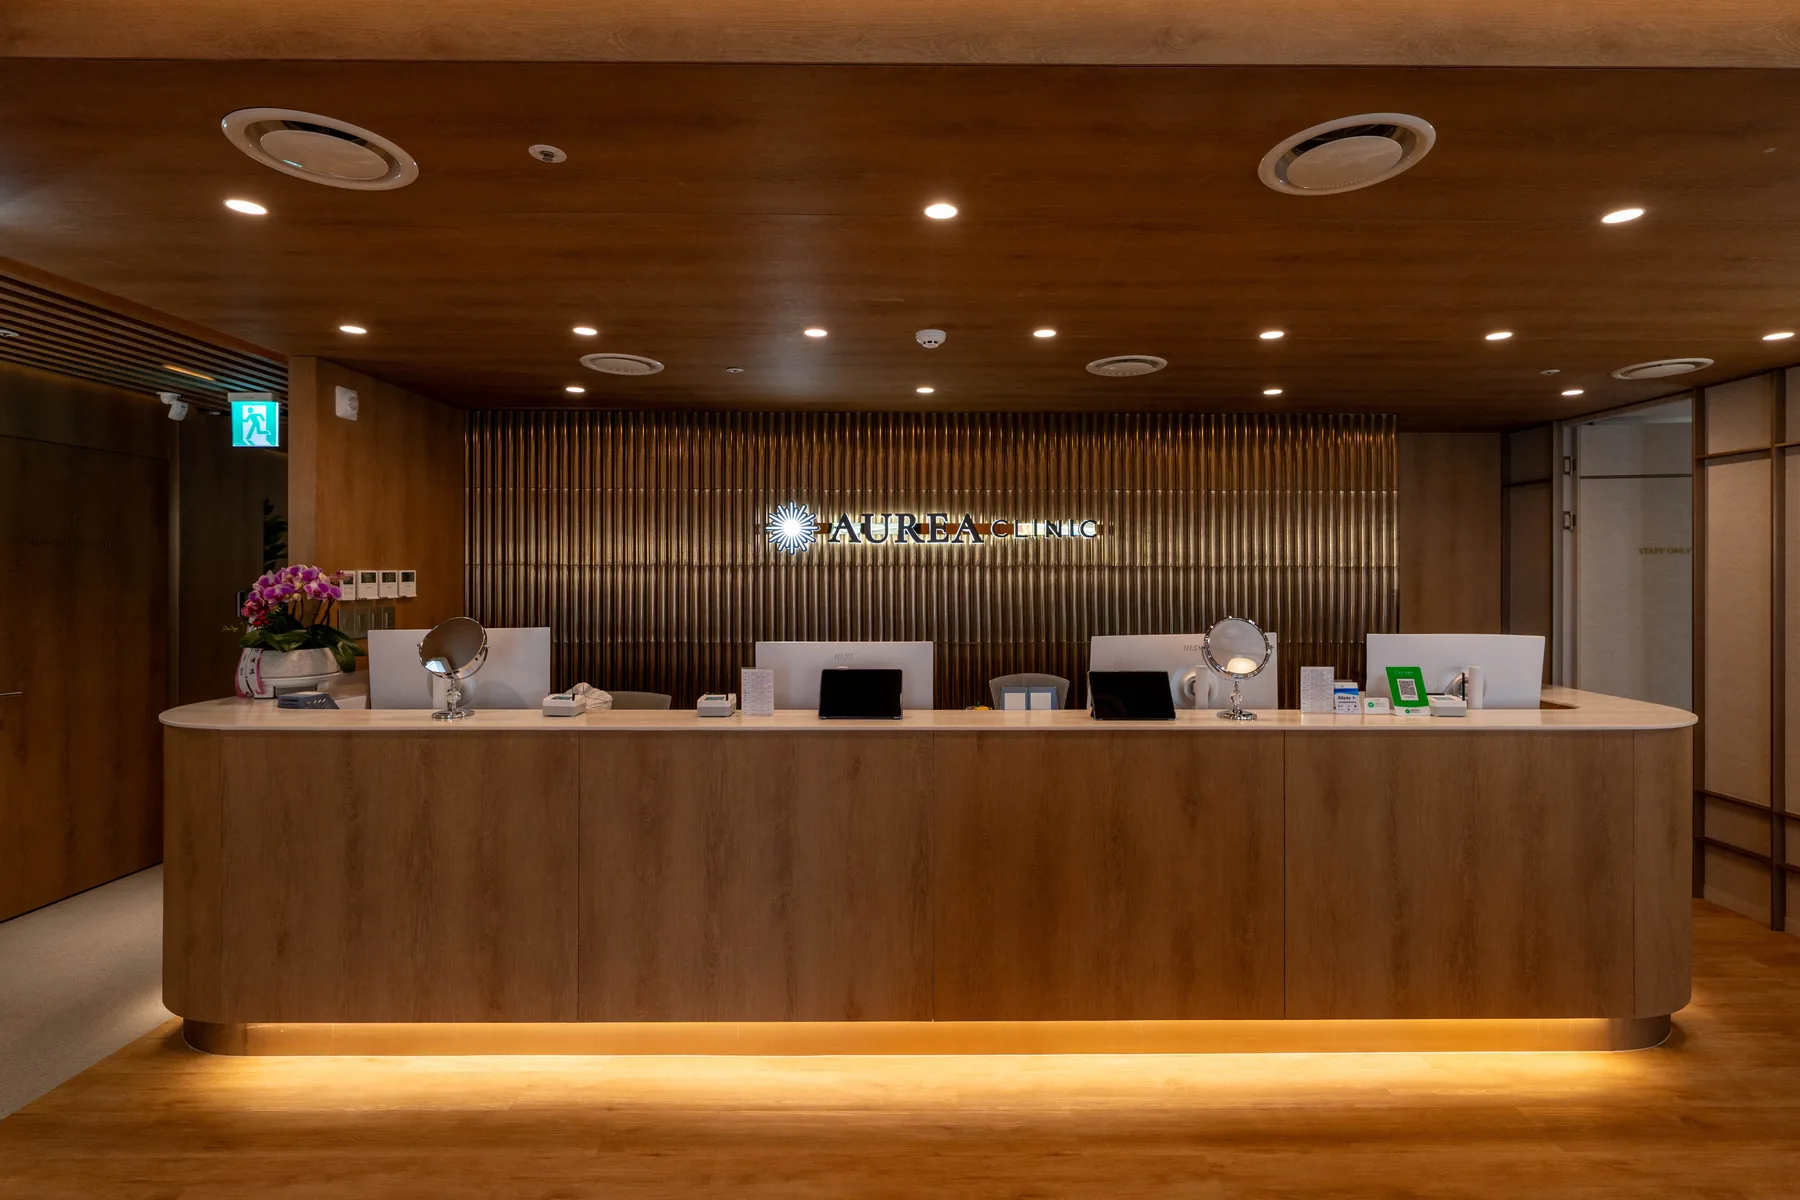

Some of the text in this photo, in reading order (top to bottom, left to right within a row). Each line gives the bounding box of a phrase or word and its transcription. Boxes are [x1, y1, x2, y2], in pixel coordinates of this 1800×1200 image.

[828, 512, 1098, 544] AUREA CLINIC
[1638, 547, 1692, 555] STAFF ONLY
